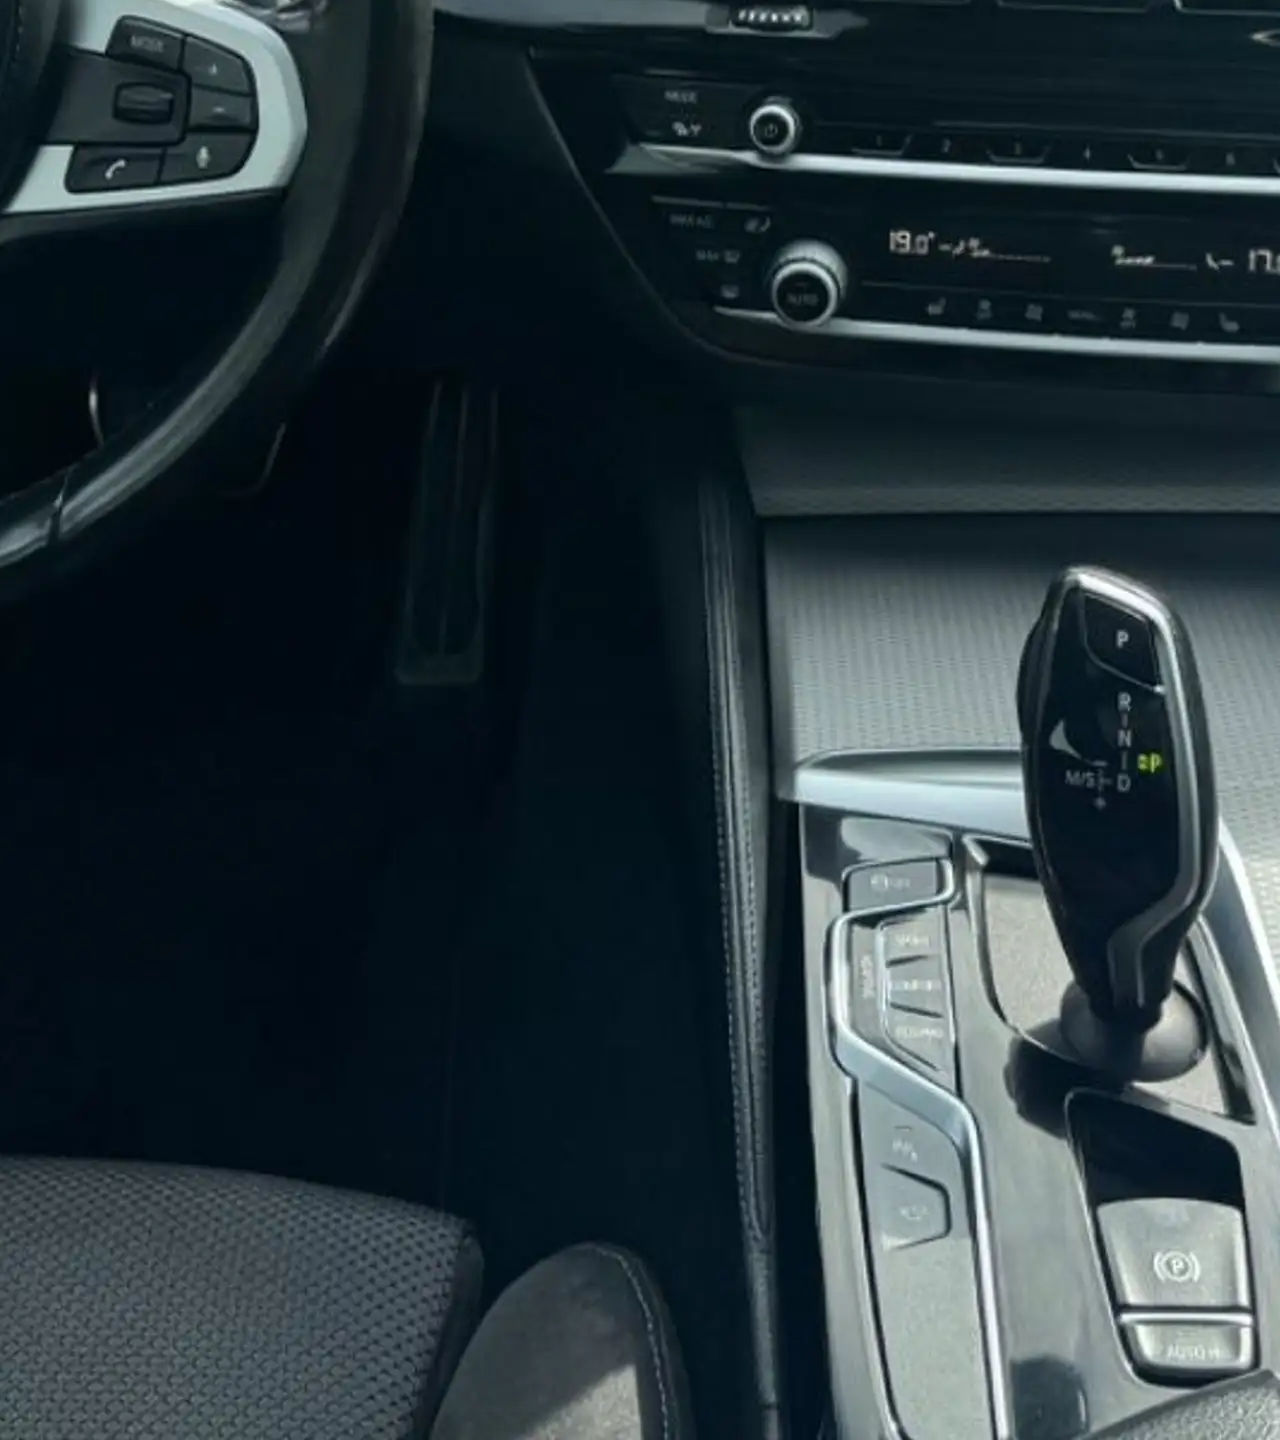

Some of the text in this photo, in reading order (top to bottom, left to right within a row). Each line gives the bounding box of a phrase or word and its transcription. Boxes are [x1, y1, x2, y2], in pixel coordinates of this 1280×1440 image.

[1116, 629, 1129, 648] P
[1117, 692, 1132, 712] R
[1117, 729, 1132, 747] N
[1117, 773, 1131, 792] D
